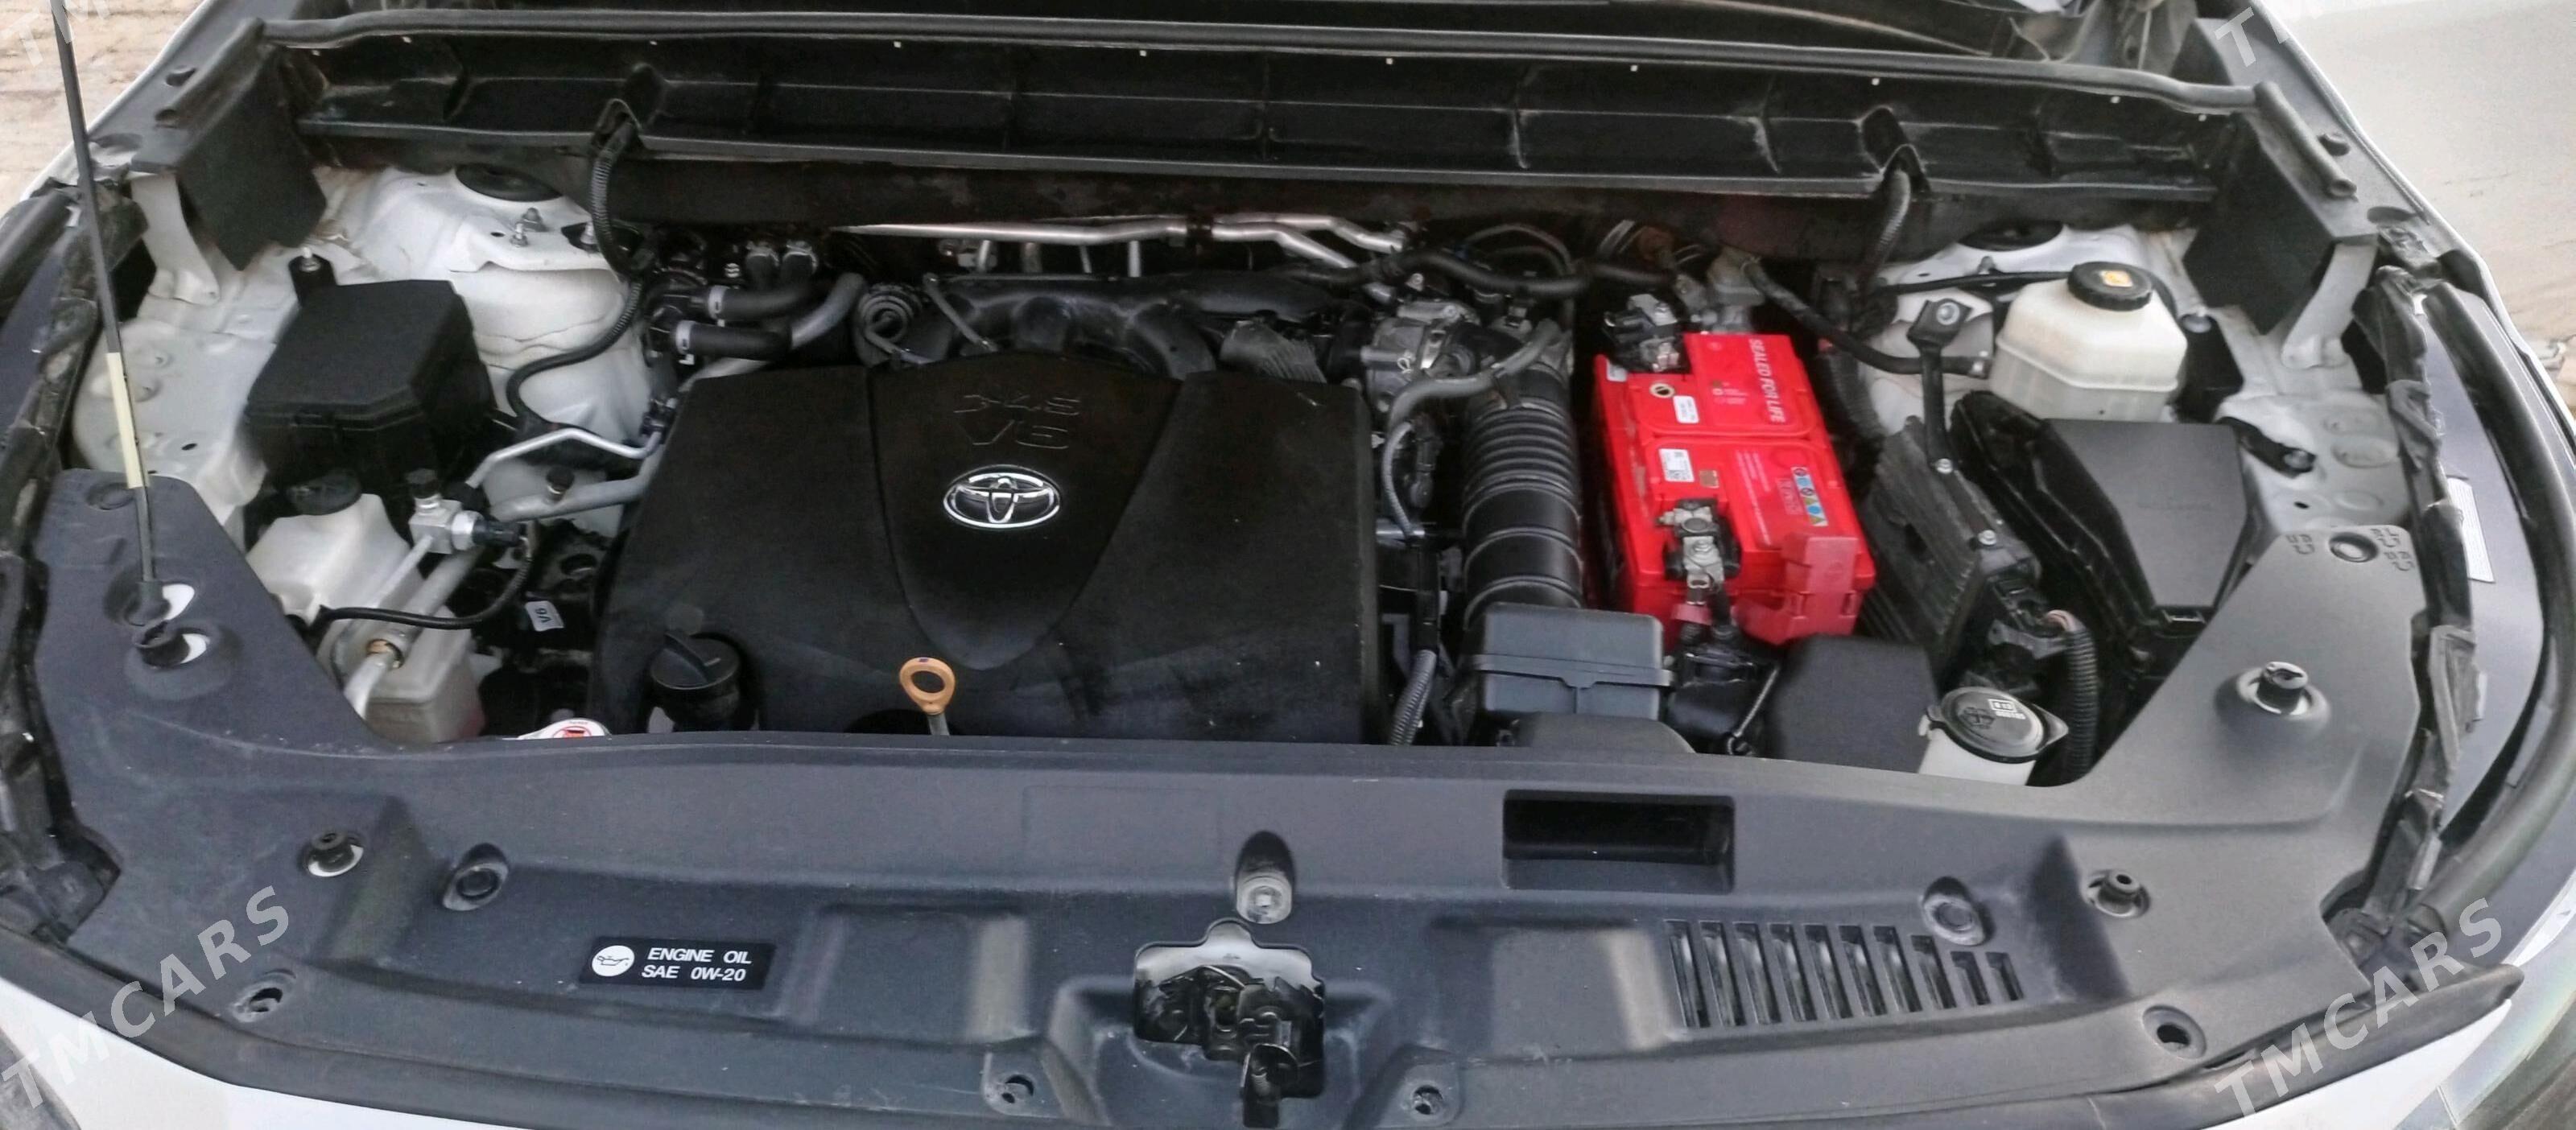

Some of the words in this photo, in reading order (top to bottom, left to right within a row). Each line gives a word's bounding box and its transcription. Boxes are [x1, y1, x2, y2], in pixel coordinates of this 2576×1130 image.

[1748, 338, 1772, 377] SEALED
[1760, 377, 1779, 399] FOR
[1766, 399, 1786, 423] LIFE
[646, 946, 715, 963] ENGINE
[723, 950, 753, 964] OIL
[641, 964, 680, 979] SAE
[690, 967, 746, 982] 0W-20
